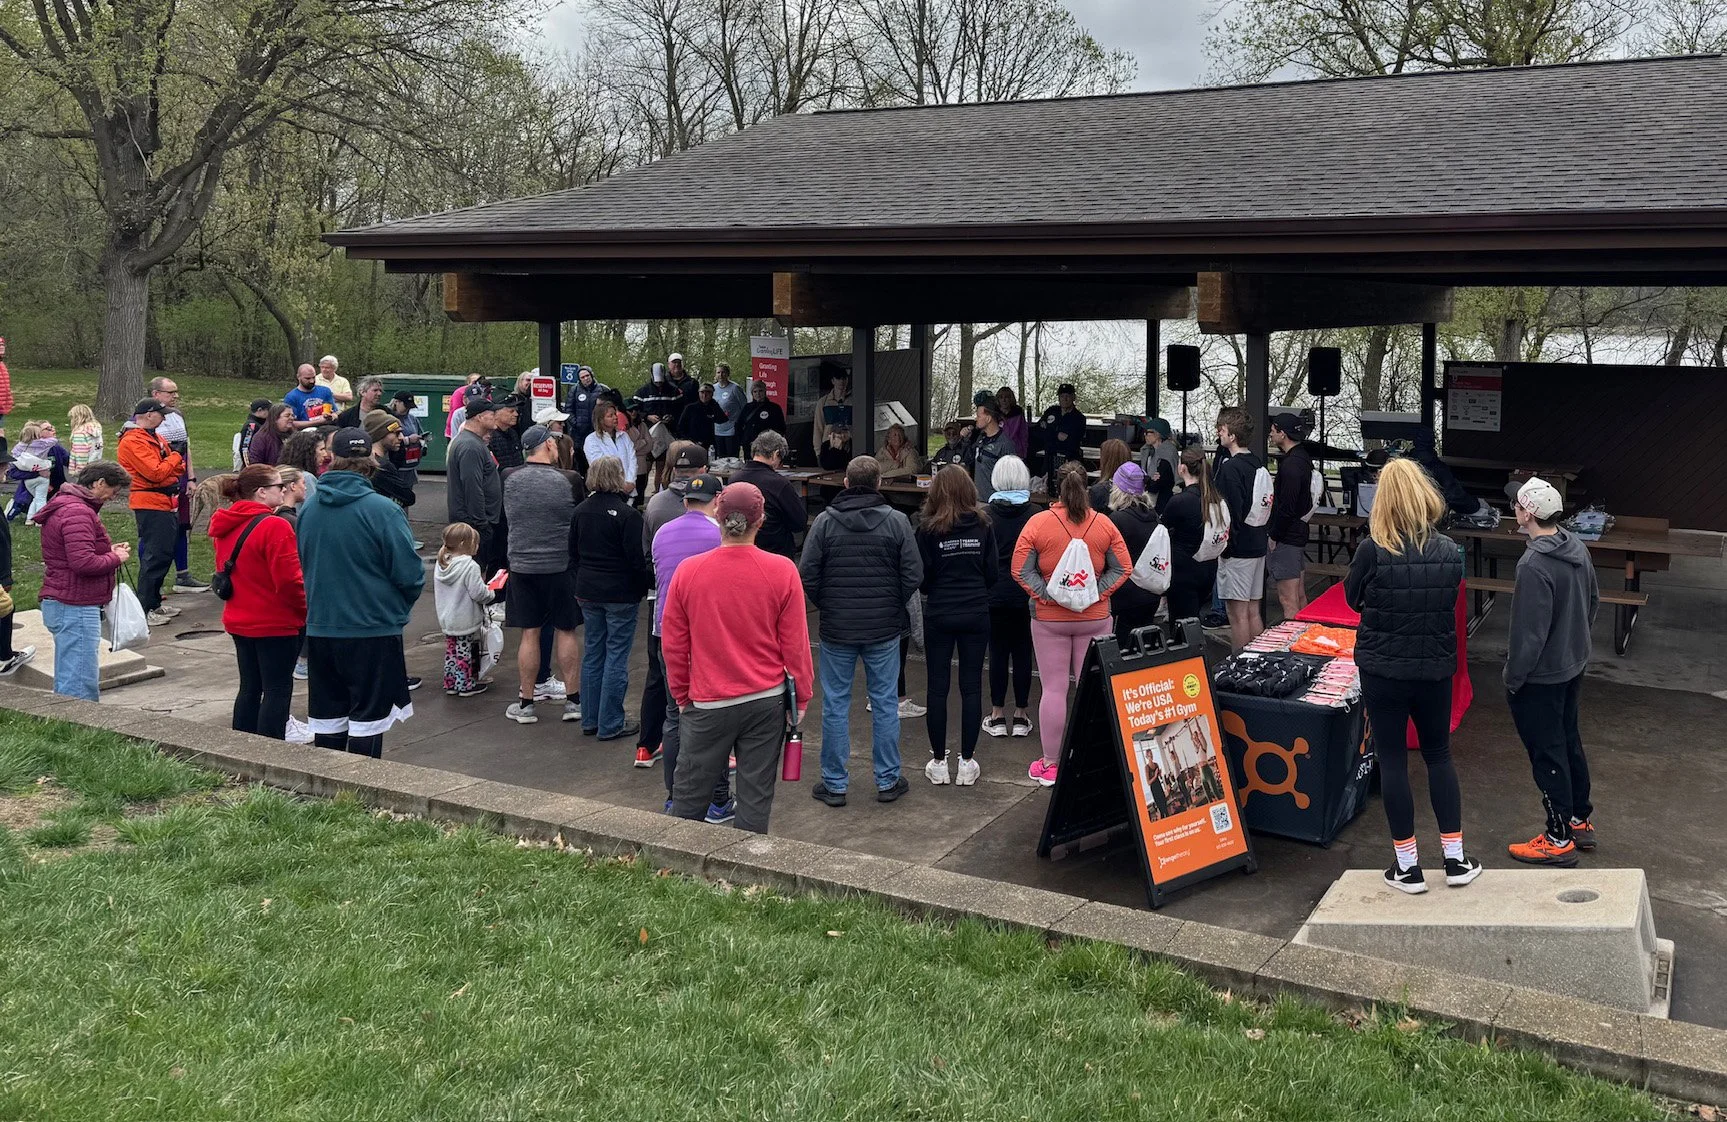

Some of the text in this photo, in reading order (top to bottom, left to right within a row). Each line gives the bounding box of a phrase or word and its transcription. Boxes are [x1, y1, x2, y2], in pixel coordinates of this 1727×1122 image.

[1122, 688, 1139, 701] It's
[1138, 678, 1175, 697] Official:
[1125, 693, 1173, 714] We're USA
[1128, 703, 1198, 728] Today's #1 Gym
